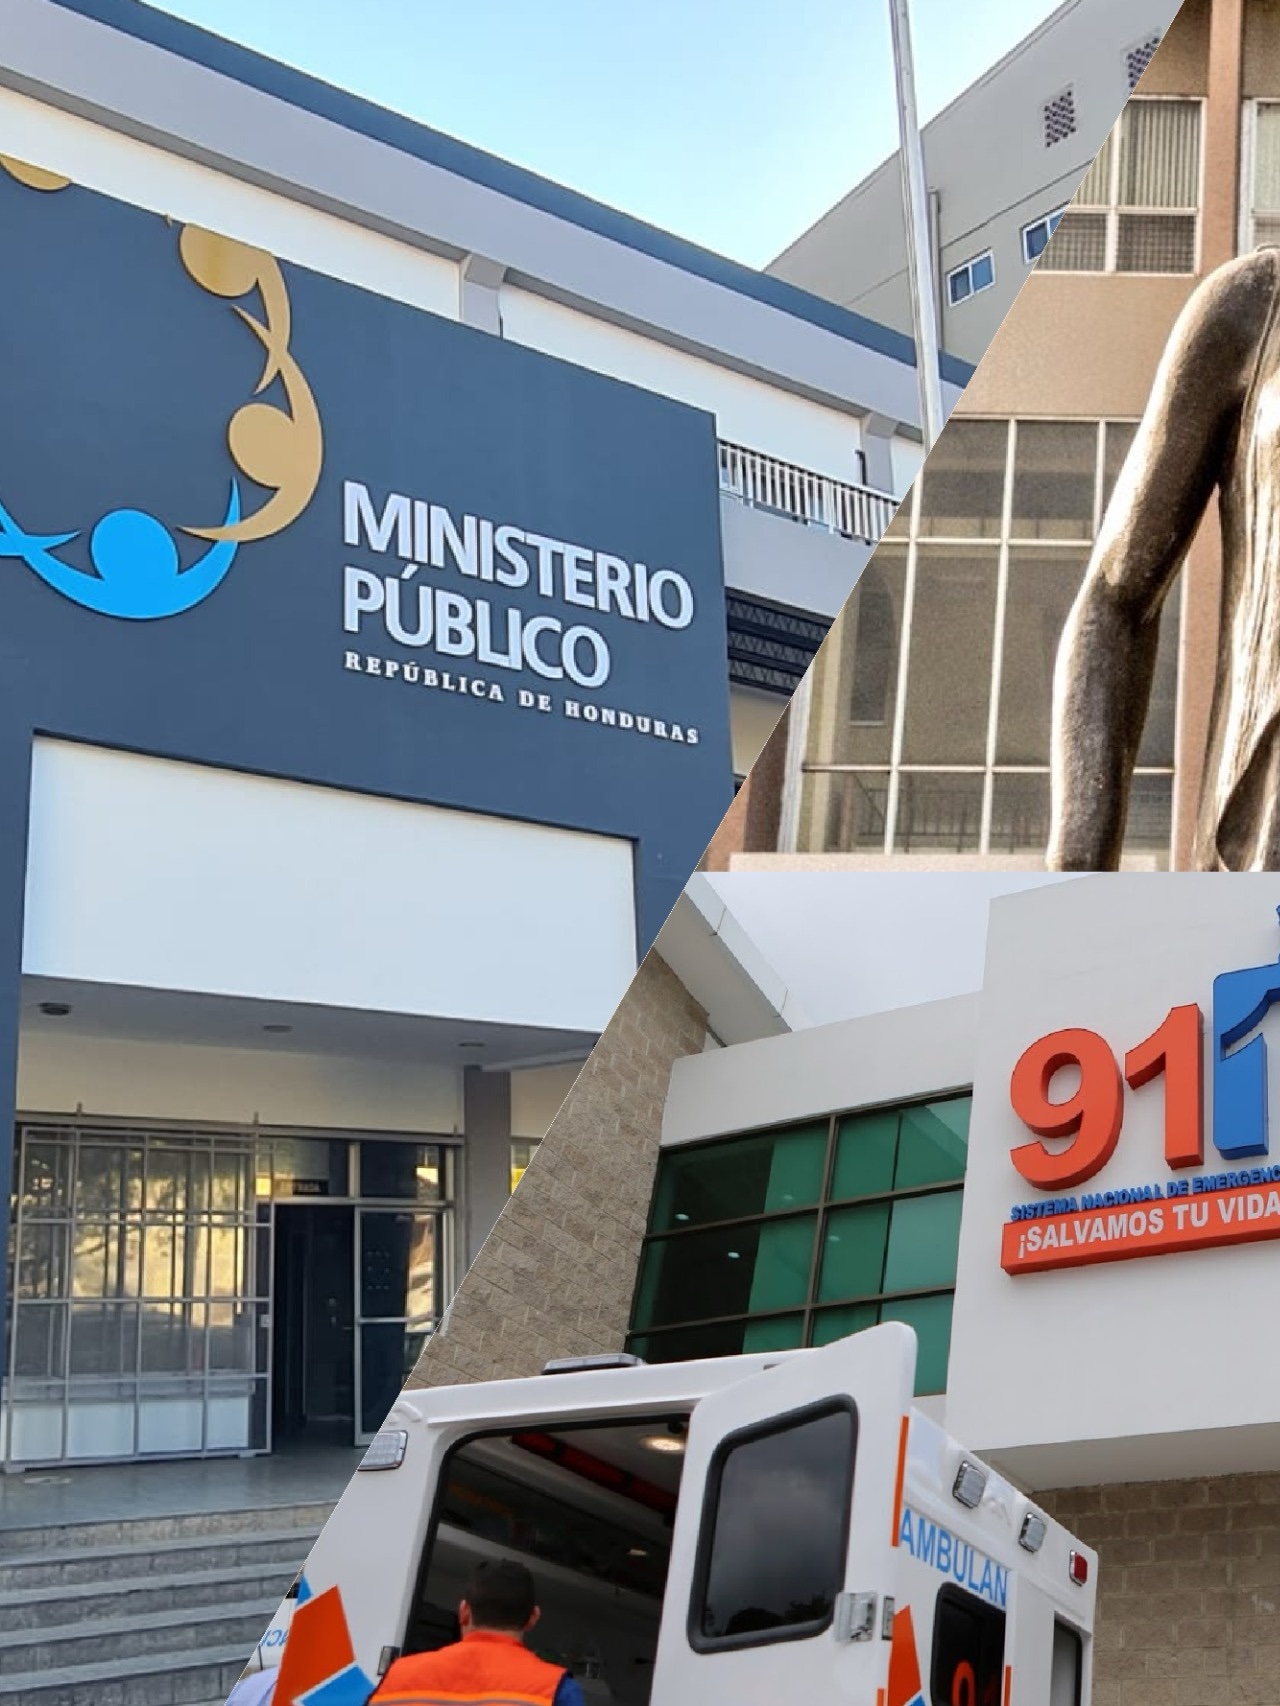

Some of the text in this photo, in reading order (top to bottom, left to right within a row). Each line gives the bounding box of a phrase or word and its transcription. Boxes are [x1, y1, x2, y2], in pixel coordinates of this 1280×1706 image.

[344, 479, 694, 630] MINISTERIO
[344, 563, 611, 688] PÚBLICO
[344, 650, 700, 745] REPÚBLICA DE HONDURAS
[1010, 1196, 1078, 1222] SISTEMA
[1081, 1186, 1165, 1210] NACIONAL
[1166, 1179, 1189, 1197] DE
[1018, 1207, 1165, 1259] ¡SALVAMOS
[1172, 1201, 1209, 1230] TU
